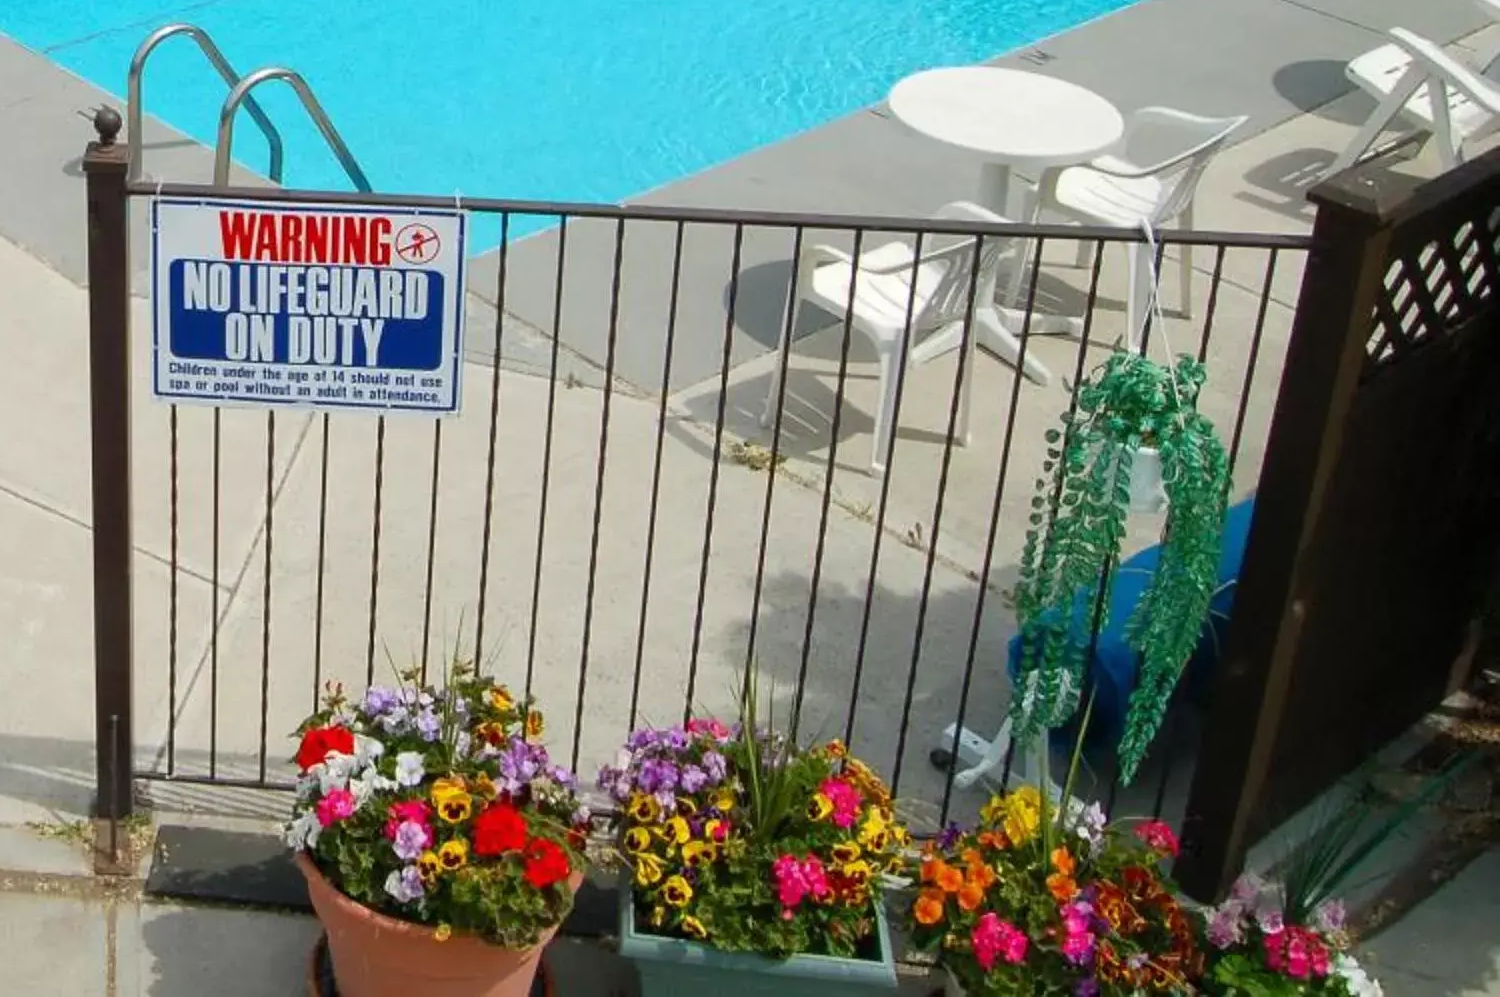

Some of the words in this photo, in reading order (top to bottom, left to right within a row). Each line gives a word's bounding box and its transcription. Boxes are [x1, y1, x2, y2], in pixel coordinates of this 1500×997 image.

[219, 211, 392, 266] WARNING
[183, 262, 231, 311] NO
[240, 265, 429, 320] LIFEGUARD
[225, 312, 274, 362] ON
[288, 317, 385, 367] DUTY
[169, 362, 217, 377] Children
[223, 367, 257, 378] under
[263, 367, 281, 380] the
[288, 371, 308, 384] age
[314, 370, 327, 381] of
[333, 370, 345, 382] 14
[351, 372, 390, 385] should
[396, 374, 415, 387] not
[421, 377, 442, 387] use
[169, 379, 190, 391] spa
[196, 381, 207, 390] or
[213, 381, 239, 393] pool
[245, 383, 290, 396] without
[297, 386, 310, 396] an
[318, 385, 346, 399] adult
[353, 387, 363, 399] in
[370, 388, 440, 403] attendance.
